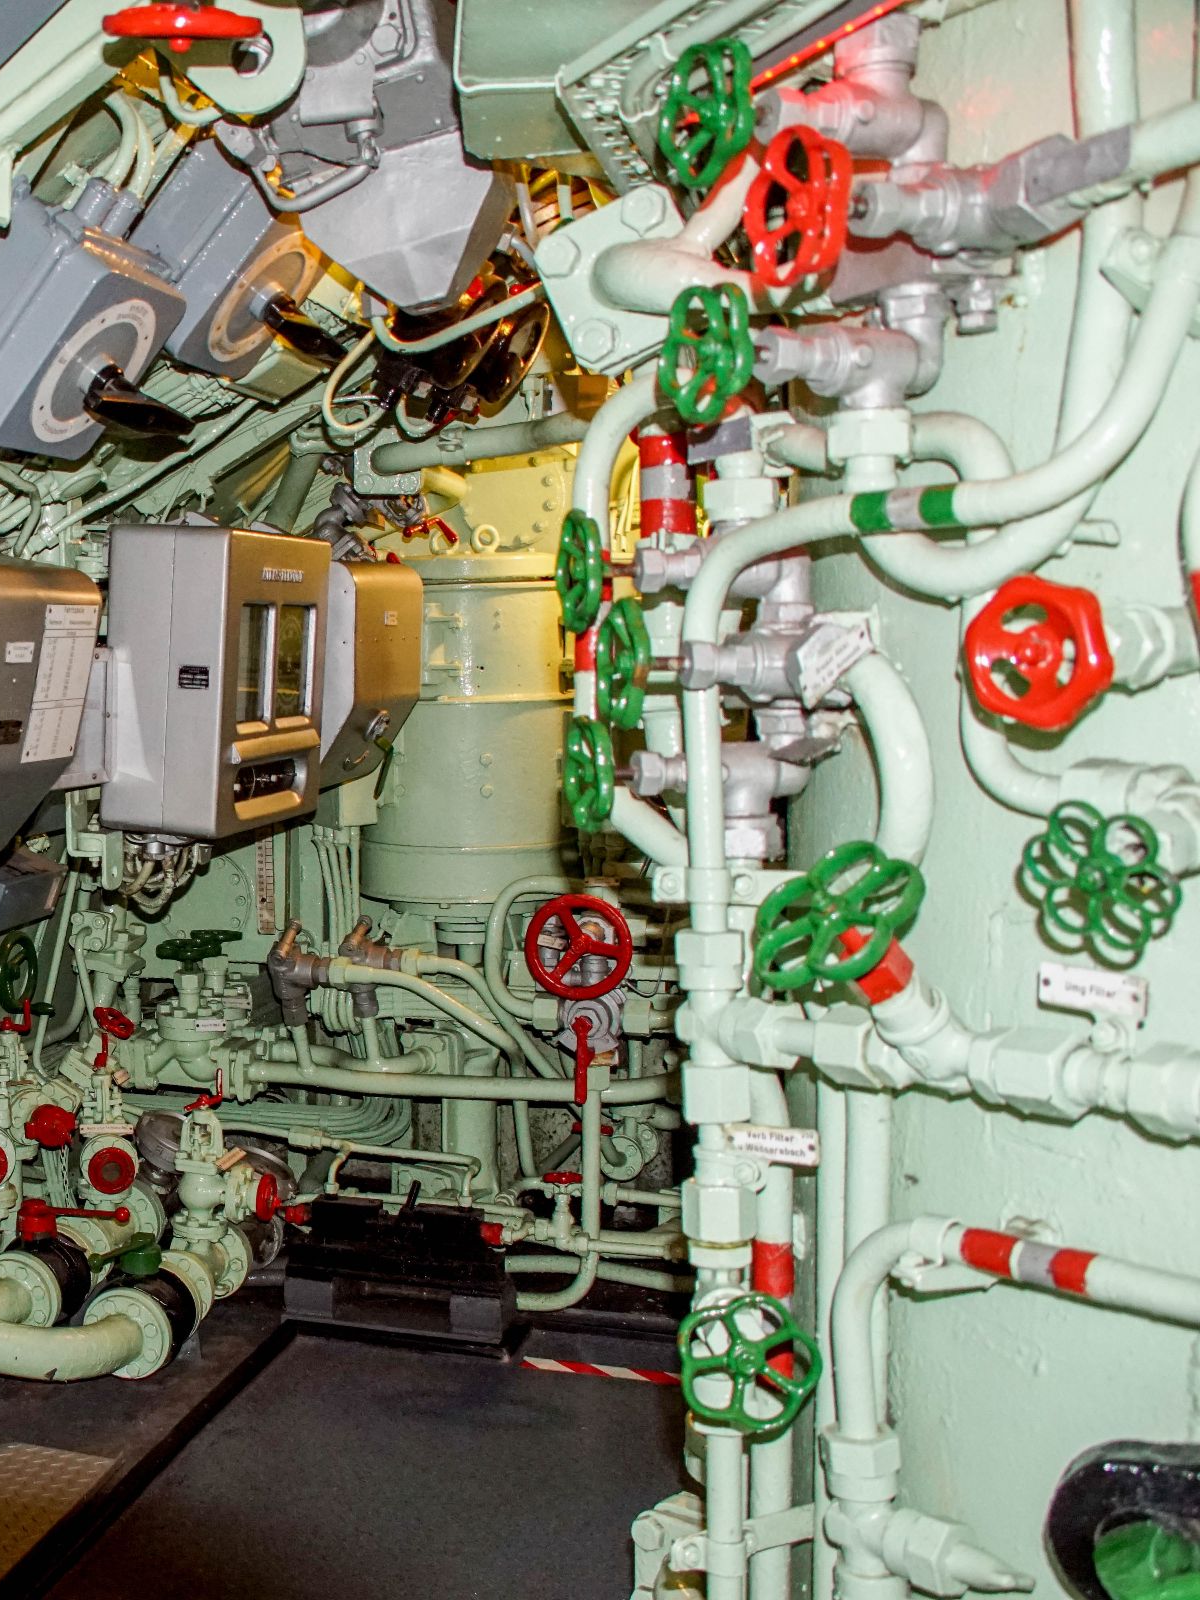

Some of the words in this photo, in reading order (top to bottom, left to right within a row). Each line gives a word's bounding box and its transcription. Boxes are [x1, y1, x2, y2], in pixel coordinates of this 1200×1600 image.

[1065, 981, 1086, 996] Umg
[1090, 984, 1116, 998] Filter
[746, 1130, 767, 1140] Verb
[769, 1131, 794, 1143] Filter
